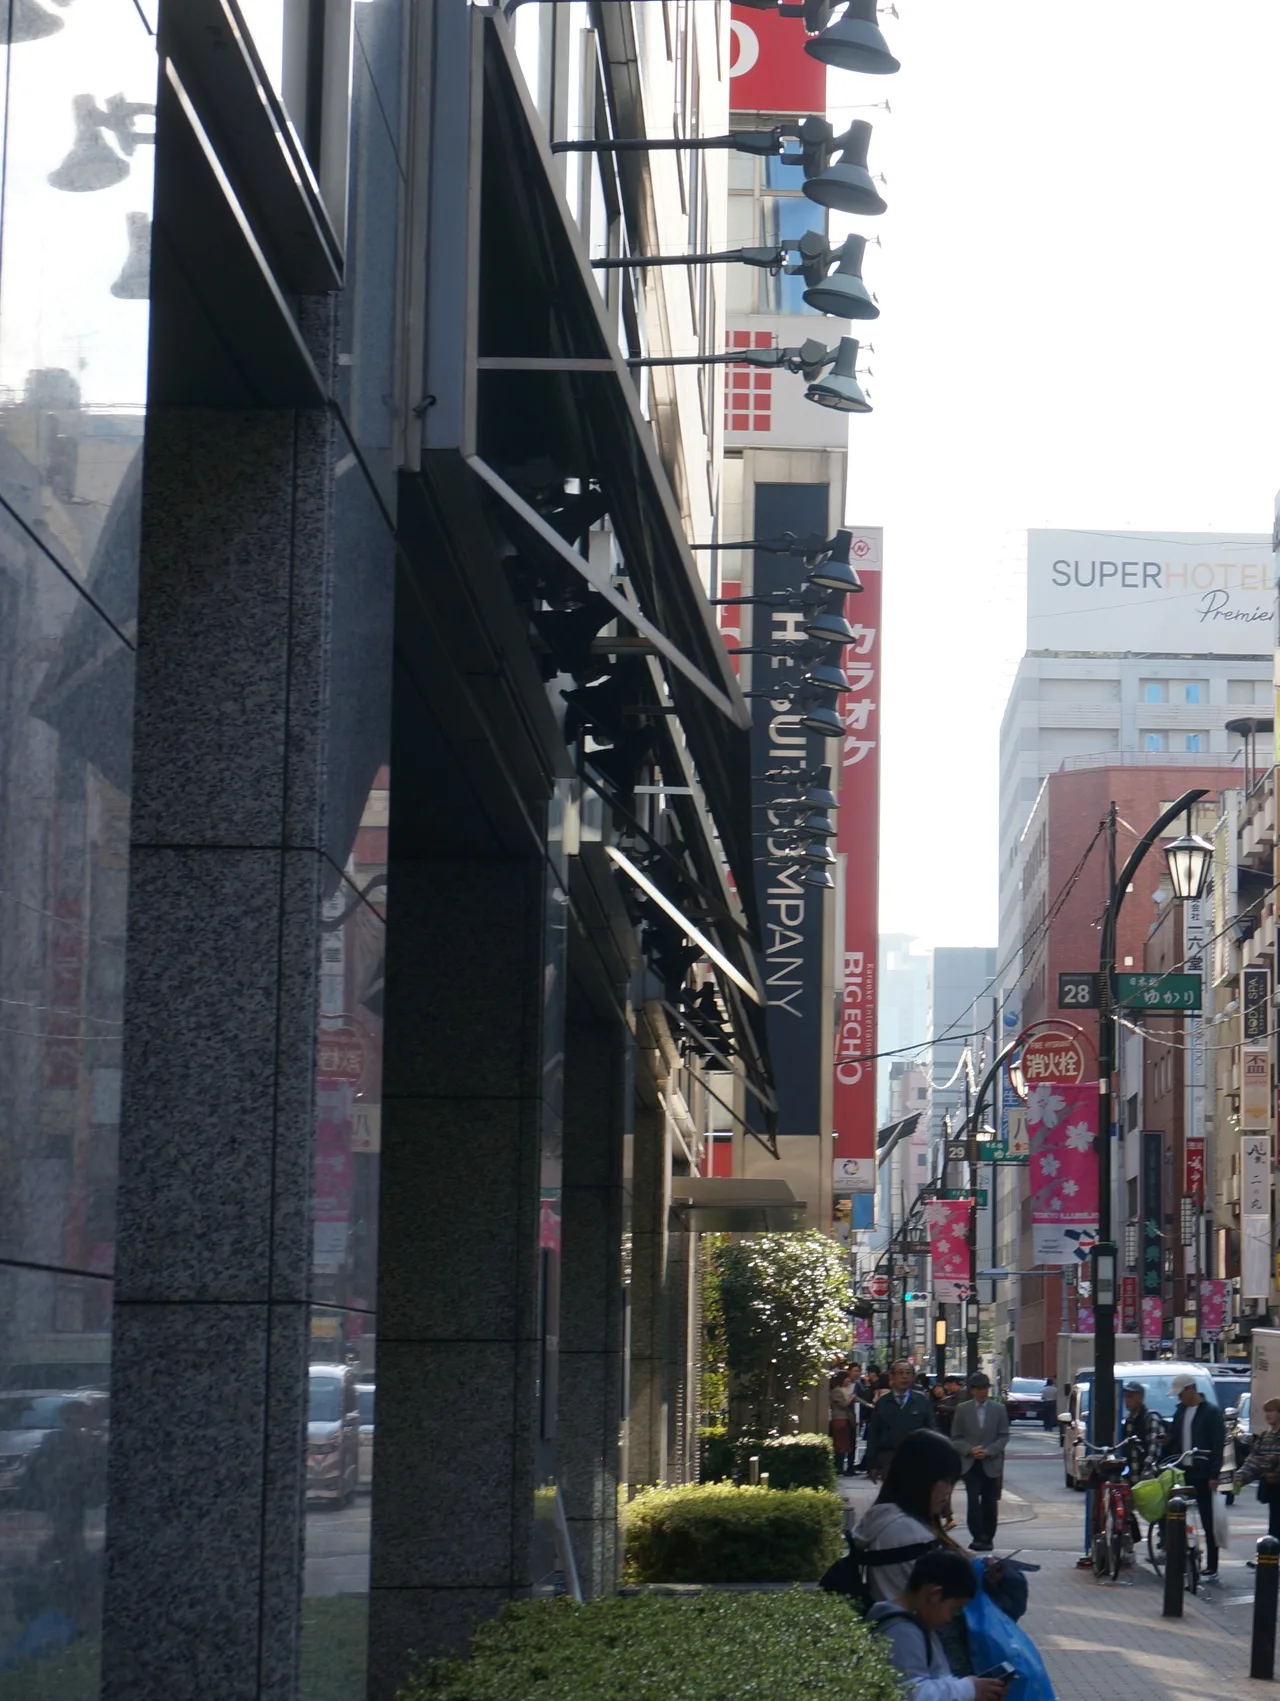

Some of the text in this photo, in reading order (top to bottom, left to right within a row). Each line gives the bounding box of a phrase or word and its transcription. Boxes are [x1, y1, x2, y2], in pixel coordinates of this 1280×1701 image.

[843, 624, 876, 767] カラオケ
[1063, 984, 1089, 1003] 28
[1144, 989, 1195, 1005] ゆかり
[836, 952, 864, 1085] BIG ECHO
[1026, 1050, 1078, 1078] 消火栓
[949, 1147, 965, 1158] 29
